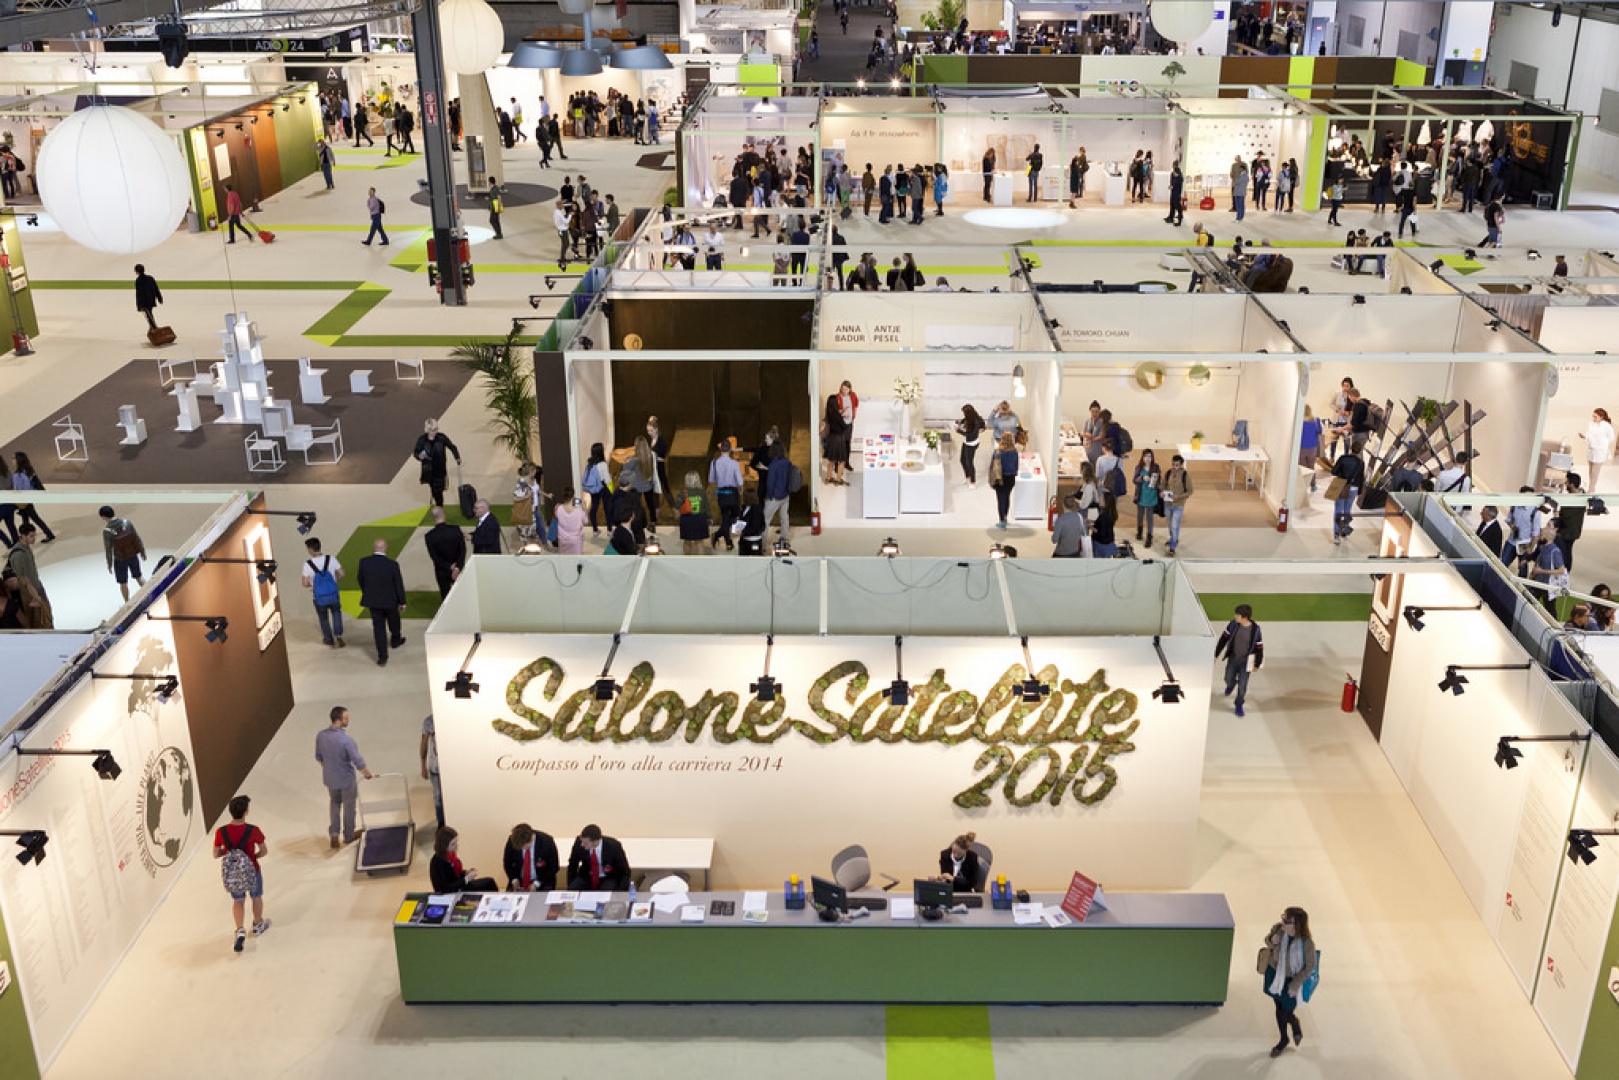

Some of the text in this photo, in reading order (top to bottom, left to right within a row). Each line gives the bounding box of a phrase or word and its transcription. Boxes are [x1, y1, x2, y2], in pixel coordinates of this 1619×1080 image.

[290, 40, 305, 51] 24
[835, 325, 861, 333] ANNA
[873, 325, 901, 333] ANTJE
[834, 334, 866, 343] BADUR
[873, 334, 899, 343] PESEL
[496, 754, 580, 776] Compasso
[631, 755, 663, 772] alla
[667, 756, 732, 772] carriera
[737, 755, 784, 772] 2014
[952, 742, 1136, 809] 2015
